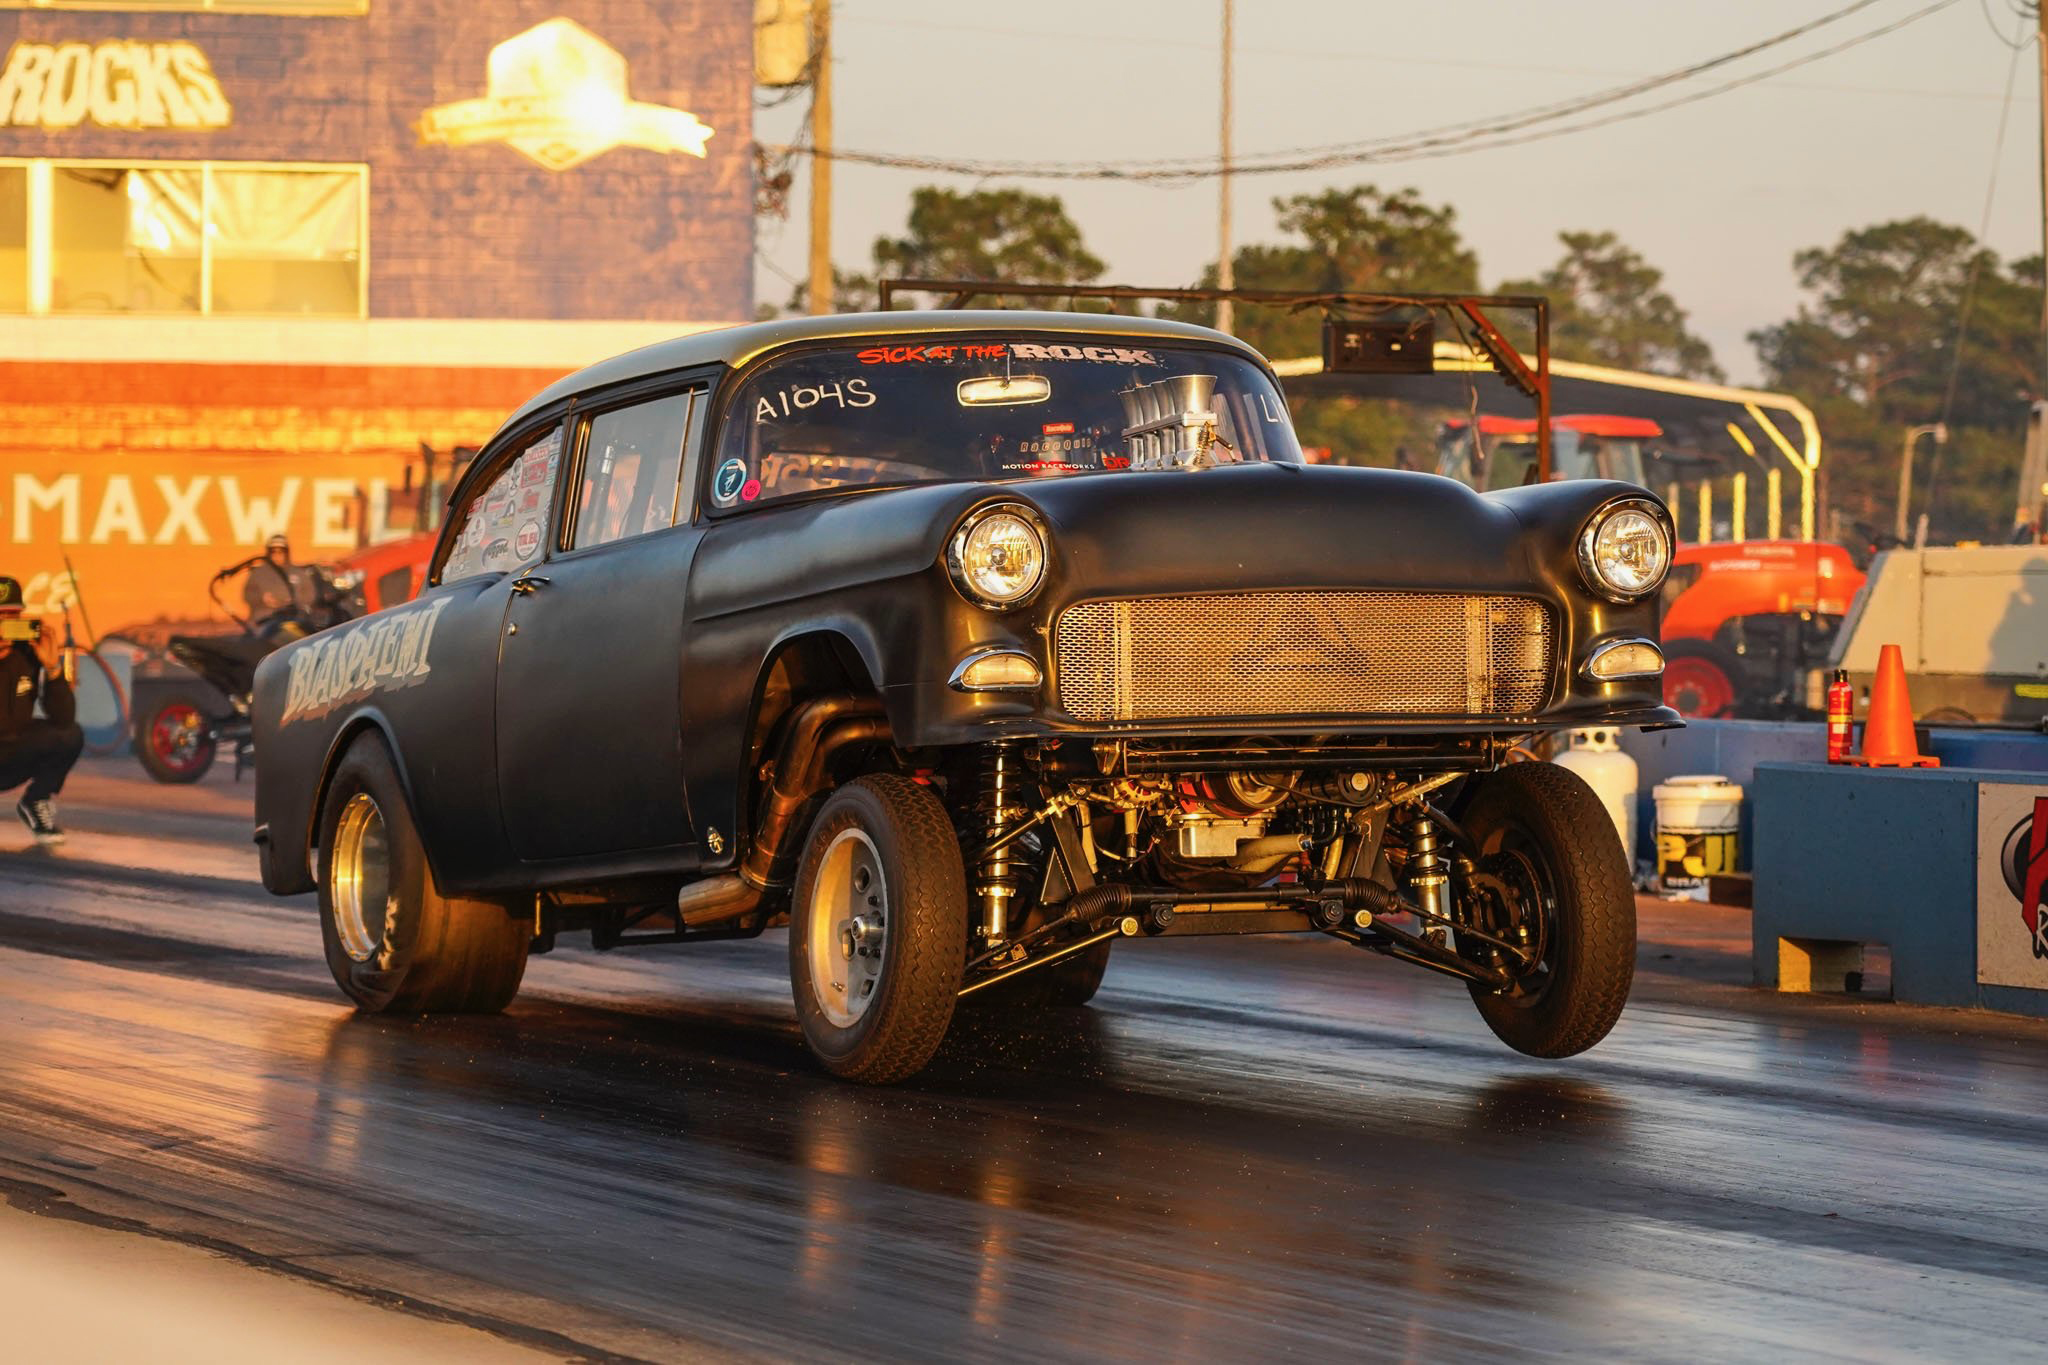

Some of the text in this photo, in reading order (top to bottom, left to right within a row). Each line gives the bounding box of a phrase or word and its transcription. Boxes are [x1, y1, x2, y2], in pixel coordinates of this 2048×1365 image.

[0, 38, 233, 129] ROCKS
[857, 343, 1156, 364] SICK AT THE ROCK
